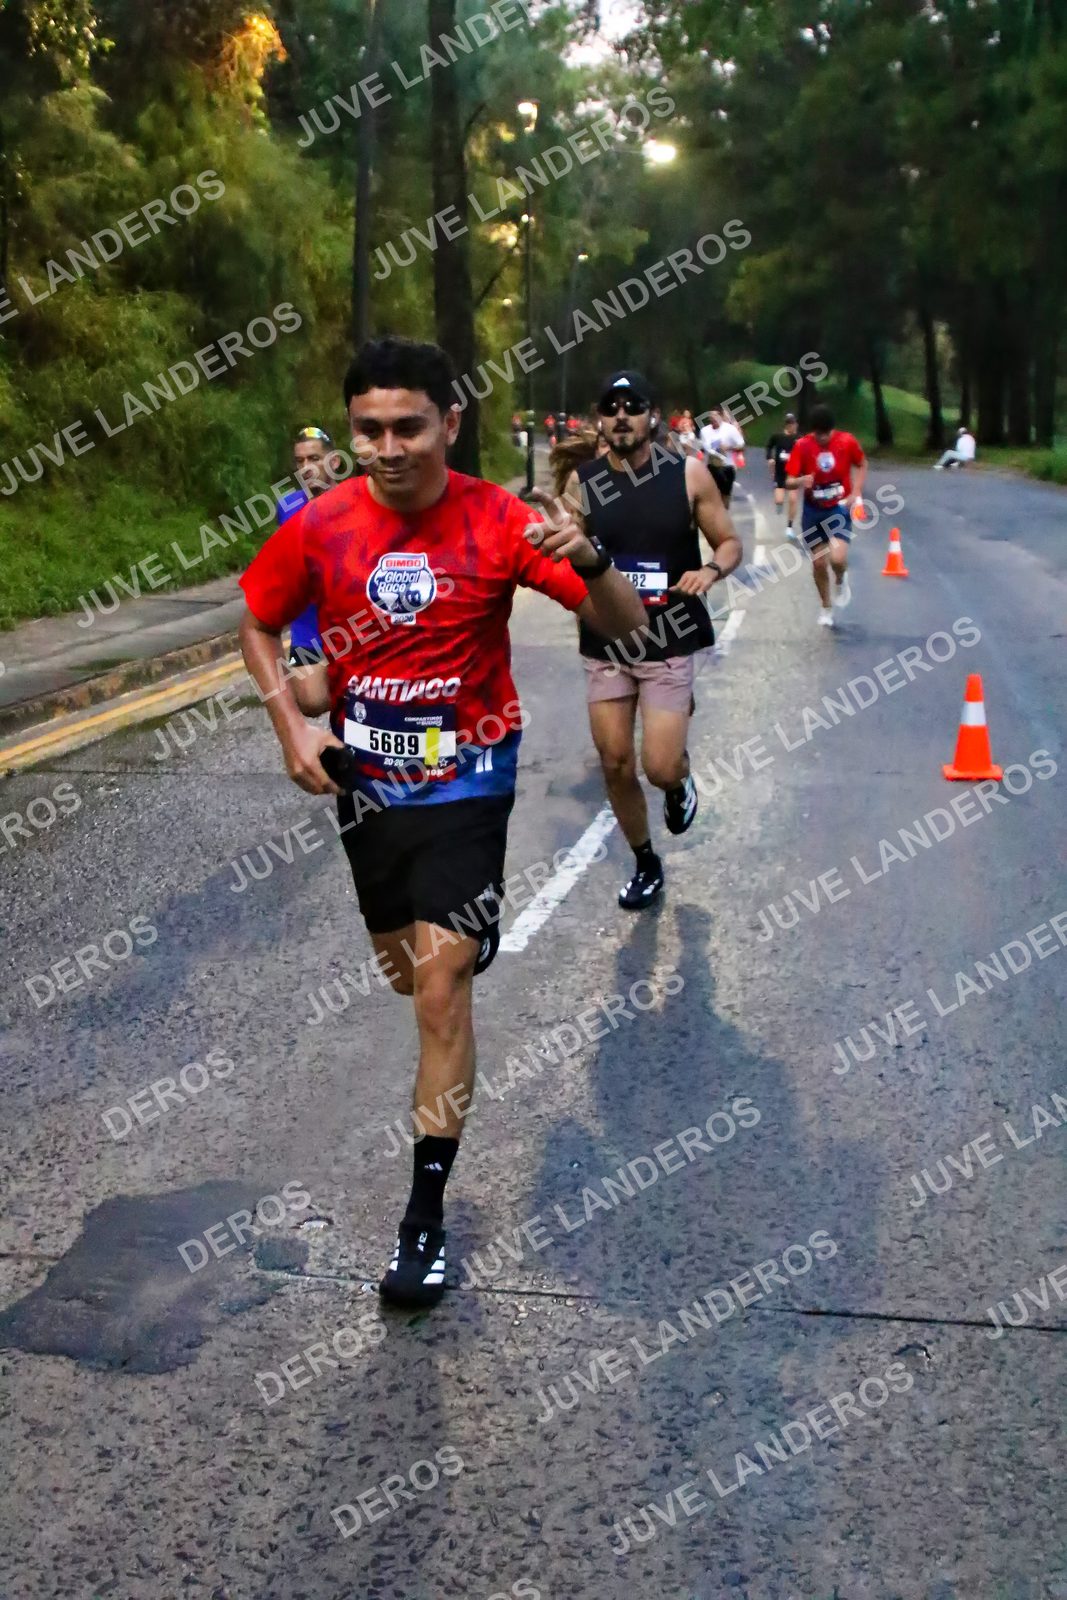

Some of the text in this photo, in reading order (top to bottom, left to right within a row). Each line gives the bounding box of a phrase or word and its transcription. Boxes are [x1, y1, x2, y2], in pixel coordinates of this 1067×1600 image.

[385, 559, 421, 567] BIMBO
[385, 570, 420, 583] Global
[377, 581, 406, 593] Race
[369, 729, 419, 755] 5689
